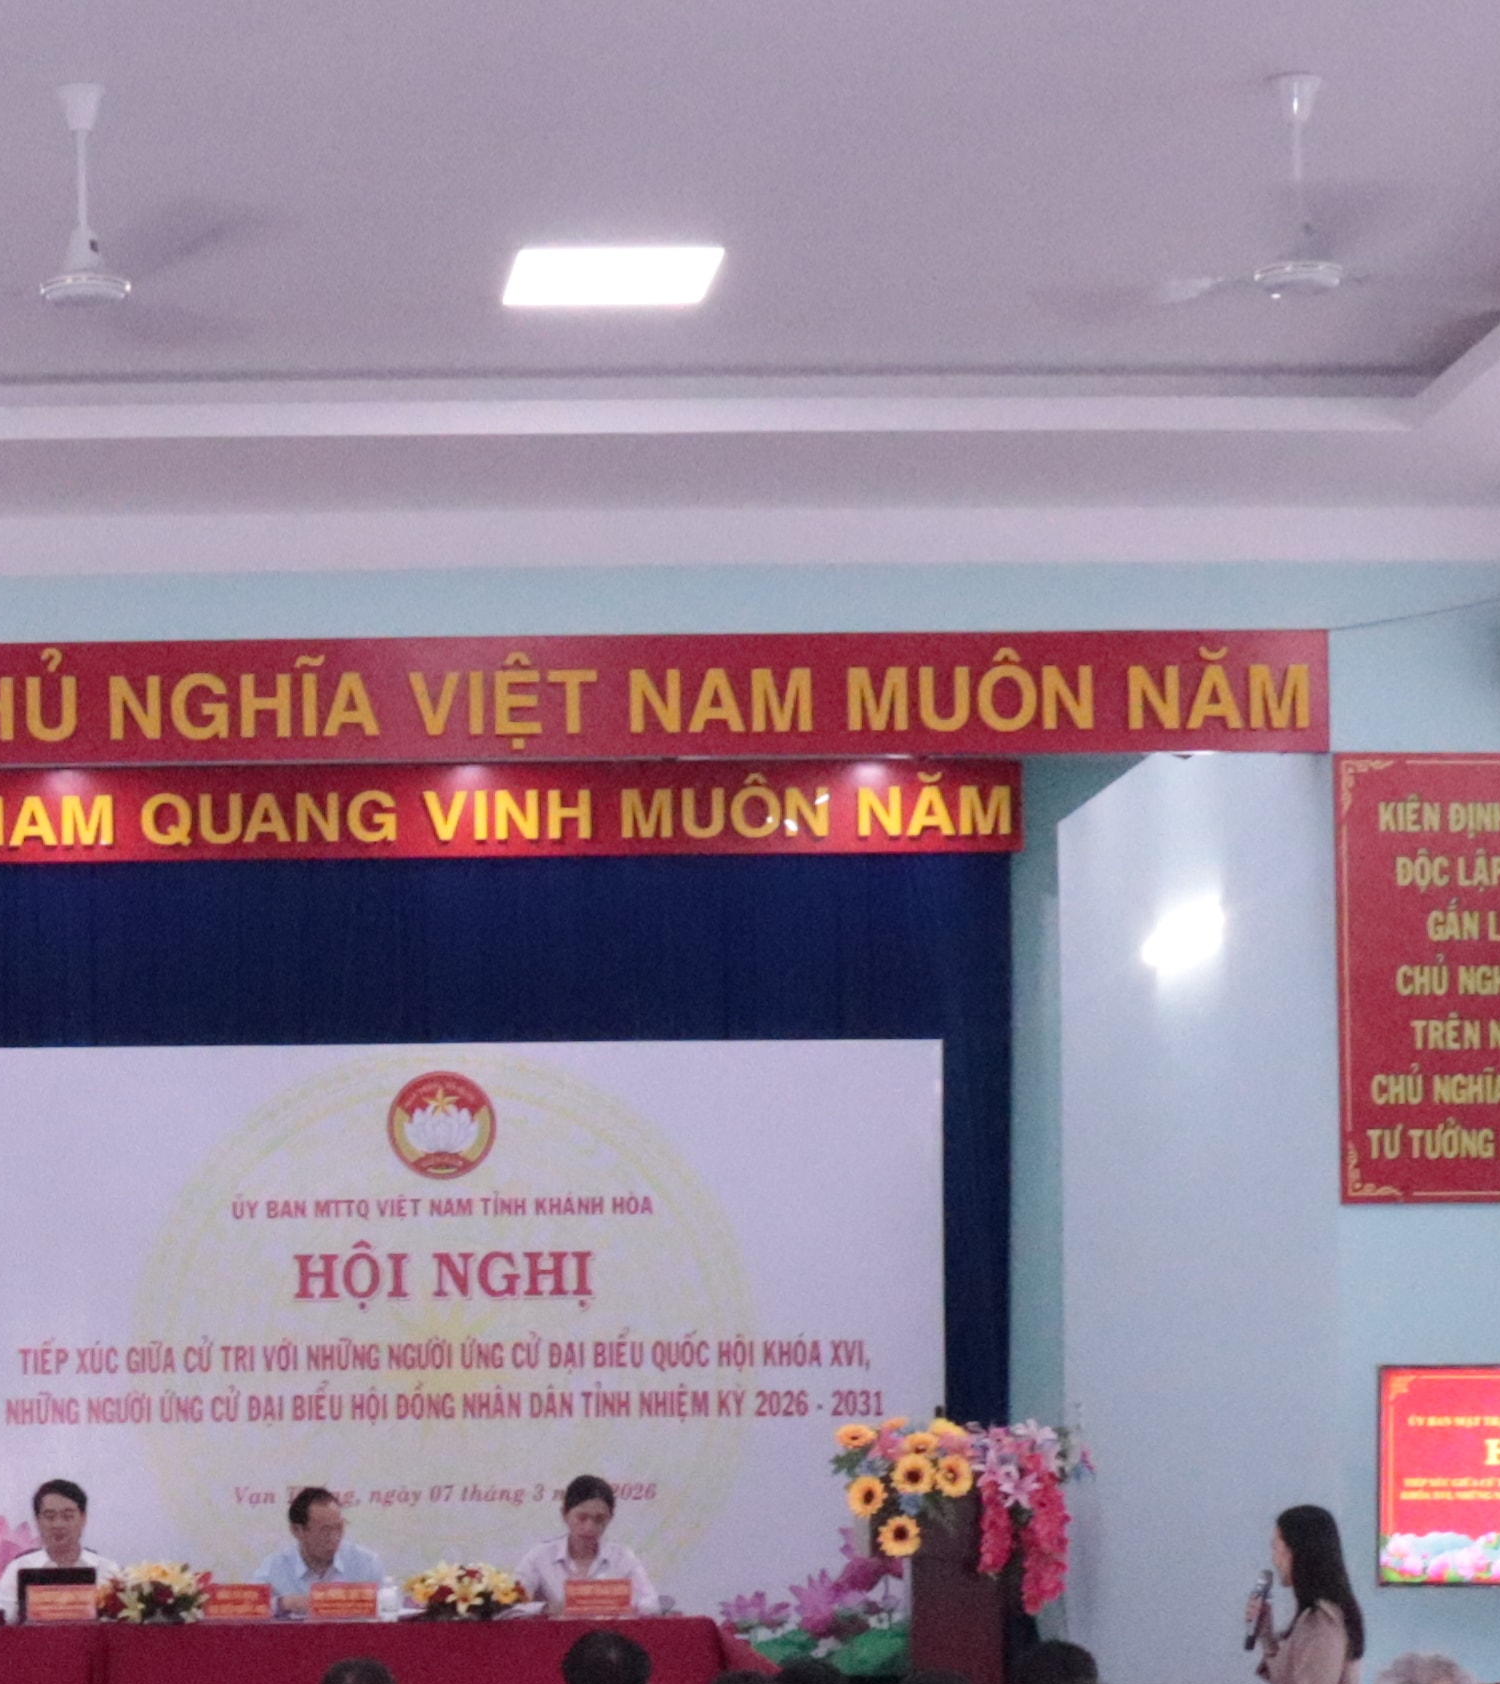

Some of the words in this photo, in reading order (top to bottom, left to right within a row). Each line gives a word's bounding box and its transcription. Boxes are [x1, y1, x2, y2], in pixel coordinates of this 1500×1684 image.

[110, 655, 380, 740] NGHĨA
[409, 651, 597, 748] VIỆT
[630, 668, 812, 732] NAM
[848, 648, 1093, 731] MUÔN
[1129, 640, 1317, 729] NĂM
[140, 790, 397, 845] QUANG
[424, 782, 590, 840] VINH
[622, 774, 834, 839] MUÔN
[852, 770, 1009, 836] NĂM
[1379, 794, 1440, 832] KIÊN
[1396, 848, 1449, 891] ĐỘC
[1427, 899, 1479, 941] GẮN
[1396, 954, 1448, 996] CHỦ
[1411, 1012, 1480, 1050] TRÊN
[1371, 1063, 1423, 1105] CHỦ
[1367, 1124, 1403, 1159] TƯ
[1408, 1118, 1494, 1159] TƯỞNG
[266, 1200, 307, 1219] BAN
[314, 1199, 370, 1220] MTTQ
[377, 1195, 421, 1219] VIỆT
[430, 1198, 473, 1216] NAM
[480, 1196, 526, 1216] TỈNH
[534, 1196, 604, 1215] KHÁNH
[612, 1195, 653, 1215] HÒA
[294, 1240, 408, 1309] HỘI
[433, 1250, 594, 1310] NGHỊ
[19, 1341, 69, 1375] TIẾP
[76, 1341, 119, 1375] XÚC
[126, 1341, 176, 1374] GIỮA
[183, 1336, 213, 1374] CỬ
[220, 1345, 255, 1372] TRI
[263, 1341, 298, 1372] VỚI
[307, 1338, 380, 1371] NHỮNG
[388, 1339, 452, 1370] NGƯỜI
[461, 1339, 504, 1370] ỨNG
[511, 1332, 541, 1369] CỬ
[549, 1342, 585, 1368] ĐẠI
[593, 1326, 644, 1369] BIỂU
[651, 1334, 710, 1372] QUỐC
[718, 1334, 755, 1371] HỘI
[762, 1331, 822, 1368] KHÓA
[830, 1340, 870, 1370] XVI,
[5, 1392, 79, 1425] NHỮNG
[87, 1391, 152, 1424] NGƯỜI
[160, 1393, 204, 1423] ỨNG
[210, 1385, 240, 1423] CỬ
[248, 1395, 284, 1422] ĐẠI
[292, 1381, 343, 1421] BIỂU
[351, 1387, 388, 1424] HỘI
[396, 1384, 455, 1420] ĐỒNG
[463, 1386, 521, 1418] NHÂN
[530, 1384, 573, 1419] DÂN
[581, 1382, 631, 1417] TỈNH
[639, 1384, 708, 1421] NHIỆM
[717, 1382, 747, 1418] KỲ
[755, 1390, 809, 1417] 2026
[831, 1390, 883, 1417] 2031
[369, 1488, 422, 1507] ngày
[429, 1484, 454, 1502] 07
[461, 1484, 525, 1506] tháng
[532, 1483, 545, 1502] 3
